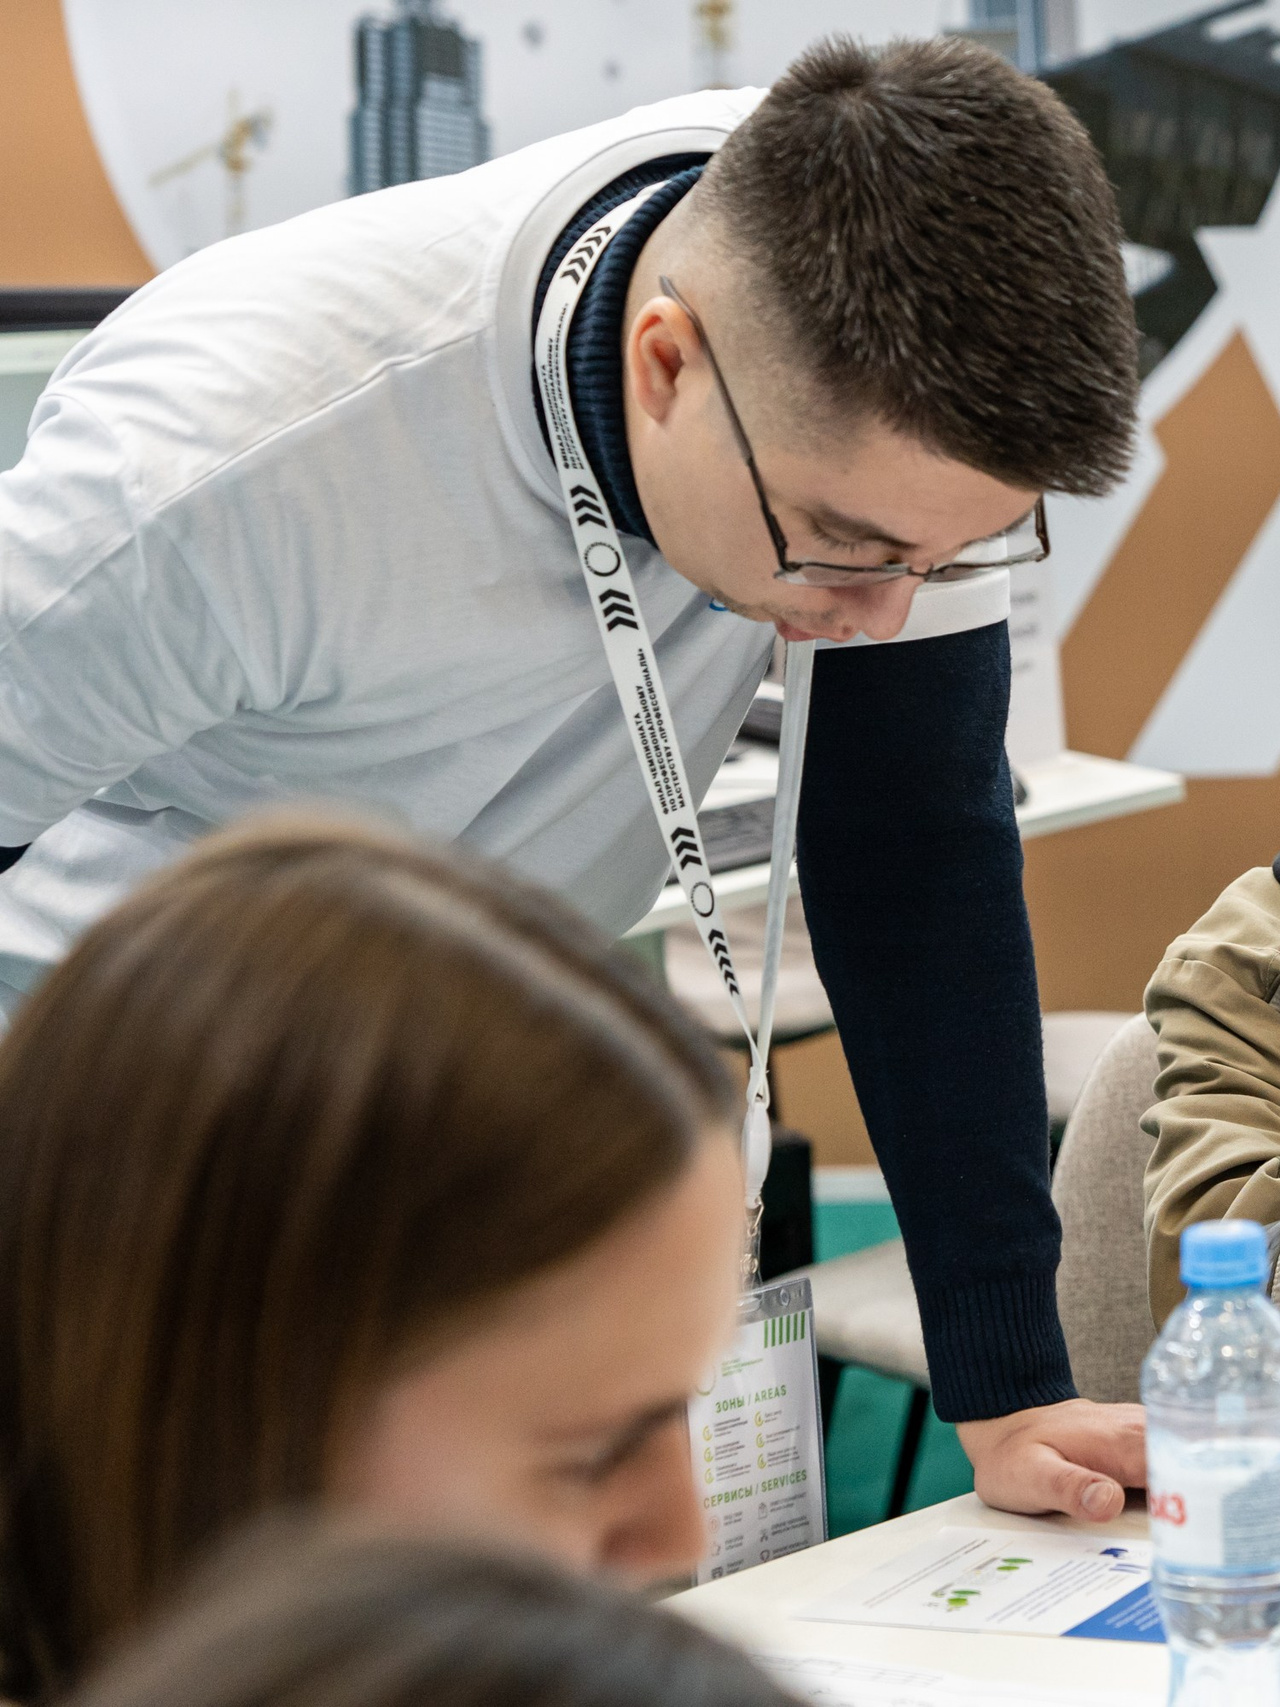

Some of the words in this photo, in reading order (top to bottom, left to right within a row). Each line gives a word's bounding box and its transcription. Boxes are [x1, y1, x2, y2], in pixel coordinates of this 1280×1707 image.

[634, 712, 658, 779] ЧЕМПИОНАТА
[636, 685, 672, 796] ПРОФЕССИОНАЛЬНОМУ
[664, 746, 686, 808] МАСТЕРСТВУ
[654, 781, 669, 815] ФИНАЛ
[669, 798, 678, 812] ПО
[715, 1396, 745, 1414] ЗОНЫ
[754, 1384, 787, 1404] AREAS
[703, 1484, 753, 1509] СЕРВИСЫ
[761, 1469, 808, 1493] SERVICES
